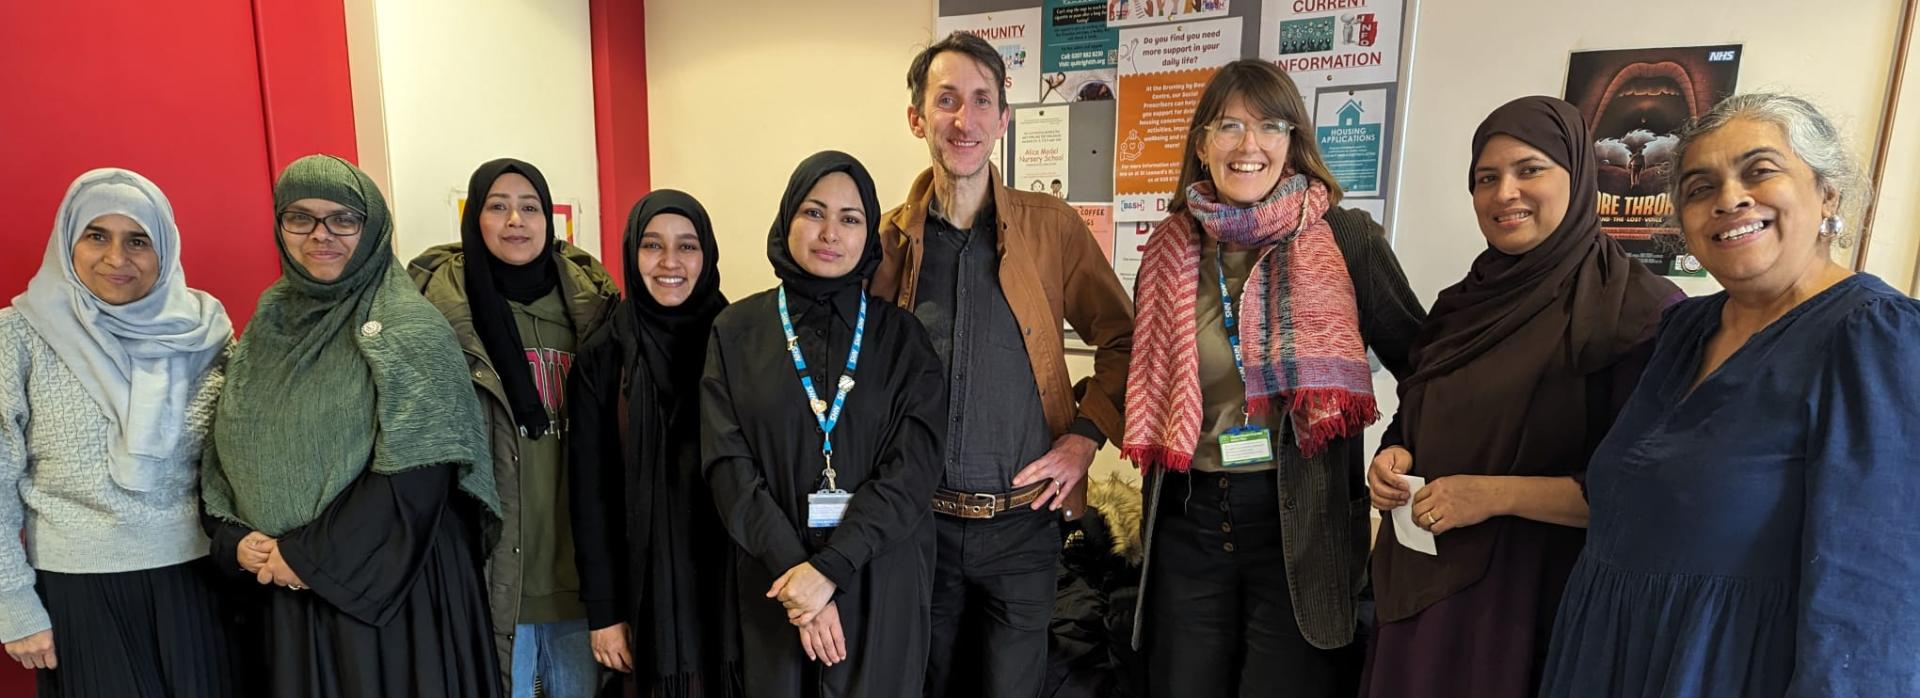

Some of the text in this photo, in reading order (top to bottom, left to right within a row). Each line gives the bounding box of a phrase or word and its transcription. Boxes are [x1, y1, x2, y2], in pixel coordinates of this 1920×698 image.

[1170, 33, 1185, 42] find
[1186, 34, 1200, 42] you
[1202, 30, 1221, 38] need
[1142, 48, 1162, 56] more
[1163, 46, 1192, 56] support
[1202, 43, 1220, 52] your
[1162, 56, 1198, 67] daily life?
[1709, 51, 1735, 61] NHS
[1321, 134, 1375, 144] APPLICATIONS
[1224, 302, 1233, 318] NHS
[1233, 344, 1241, 361] NHS
[830, 404, 842, 420] NHS
